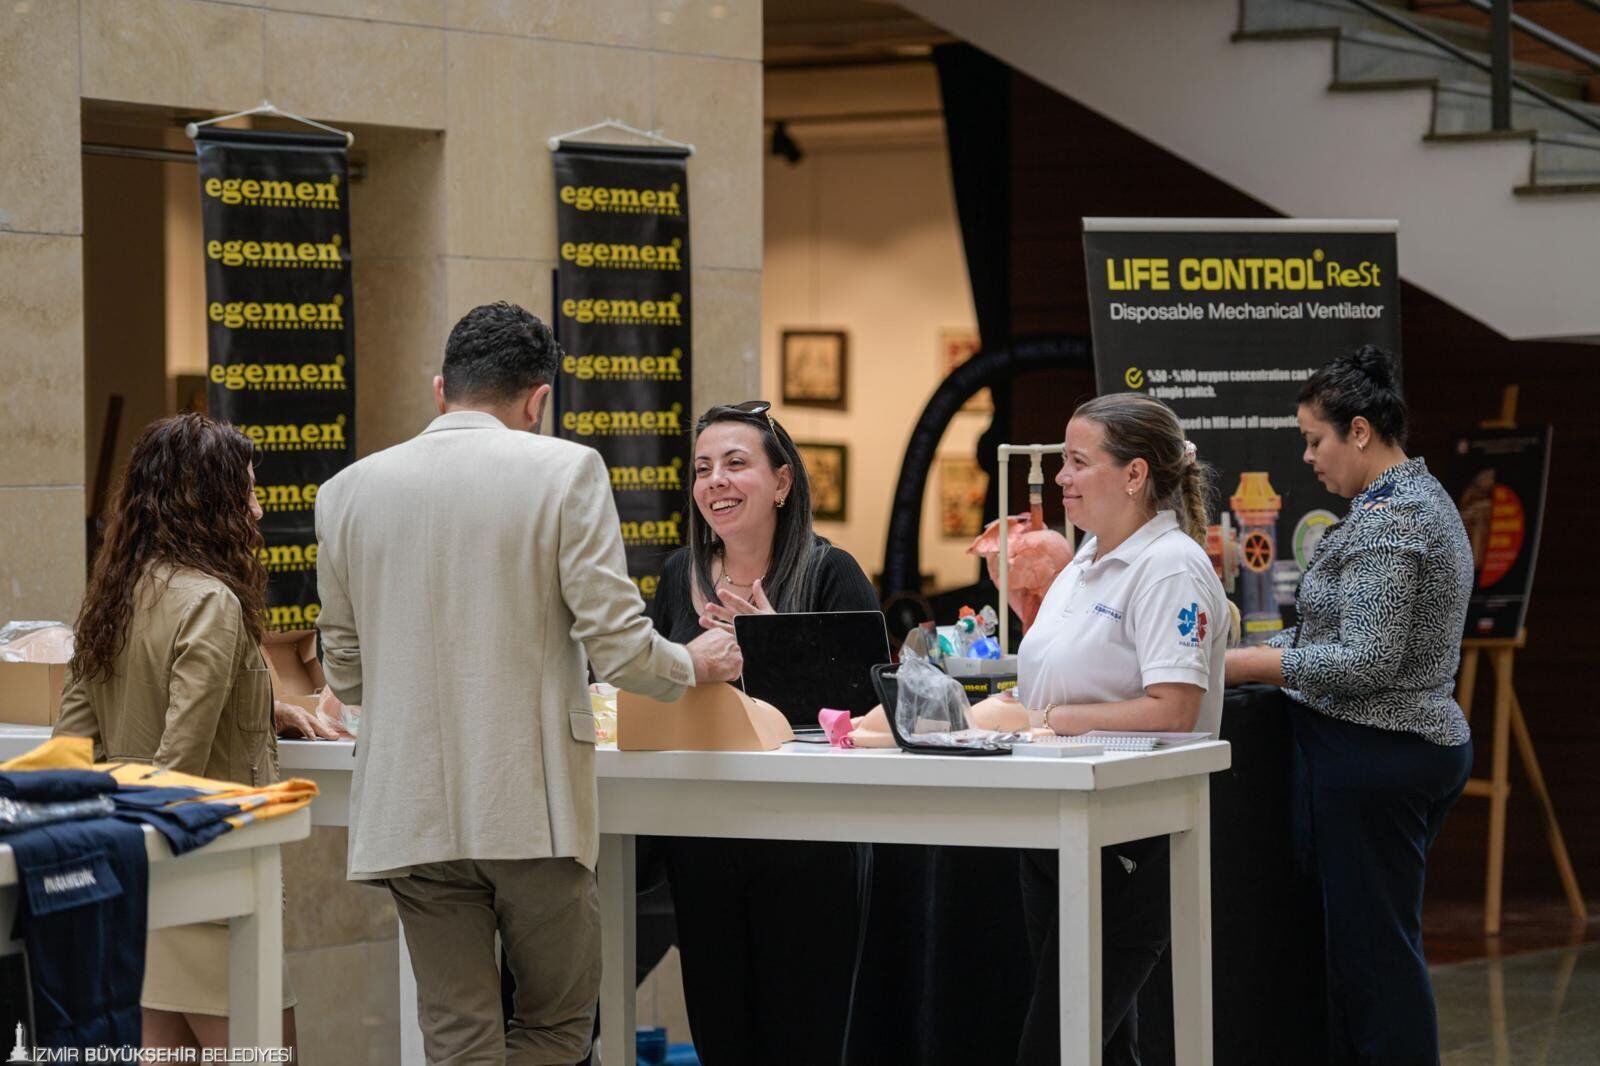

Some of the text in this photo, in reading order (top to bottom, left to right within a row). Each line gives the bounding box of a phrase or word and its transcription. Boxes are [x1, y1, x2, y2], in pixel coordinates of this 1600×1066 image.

[1107, 258, 1170, 290] LIFE
[1327, 261, 1381, 287] ReSt
[1110, 301, 1384, 323] Disposable Mechanical Ventilator
